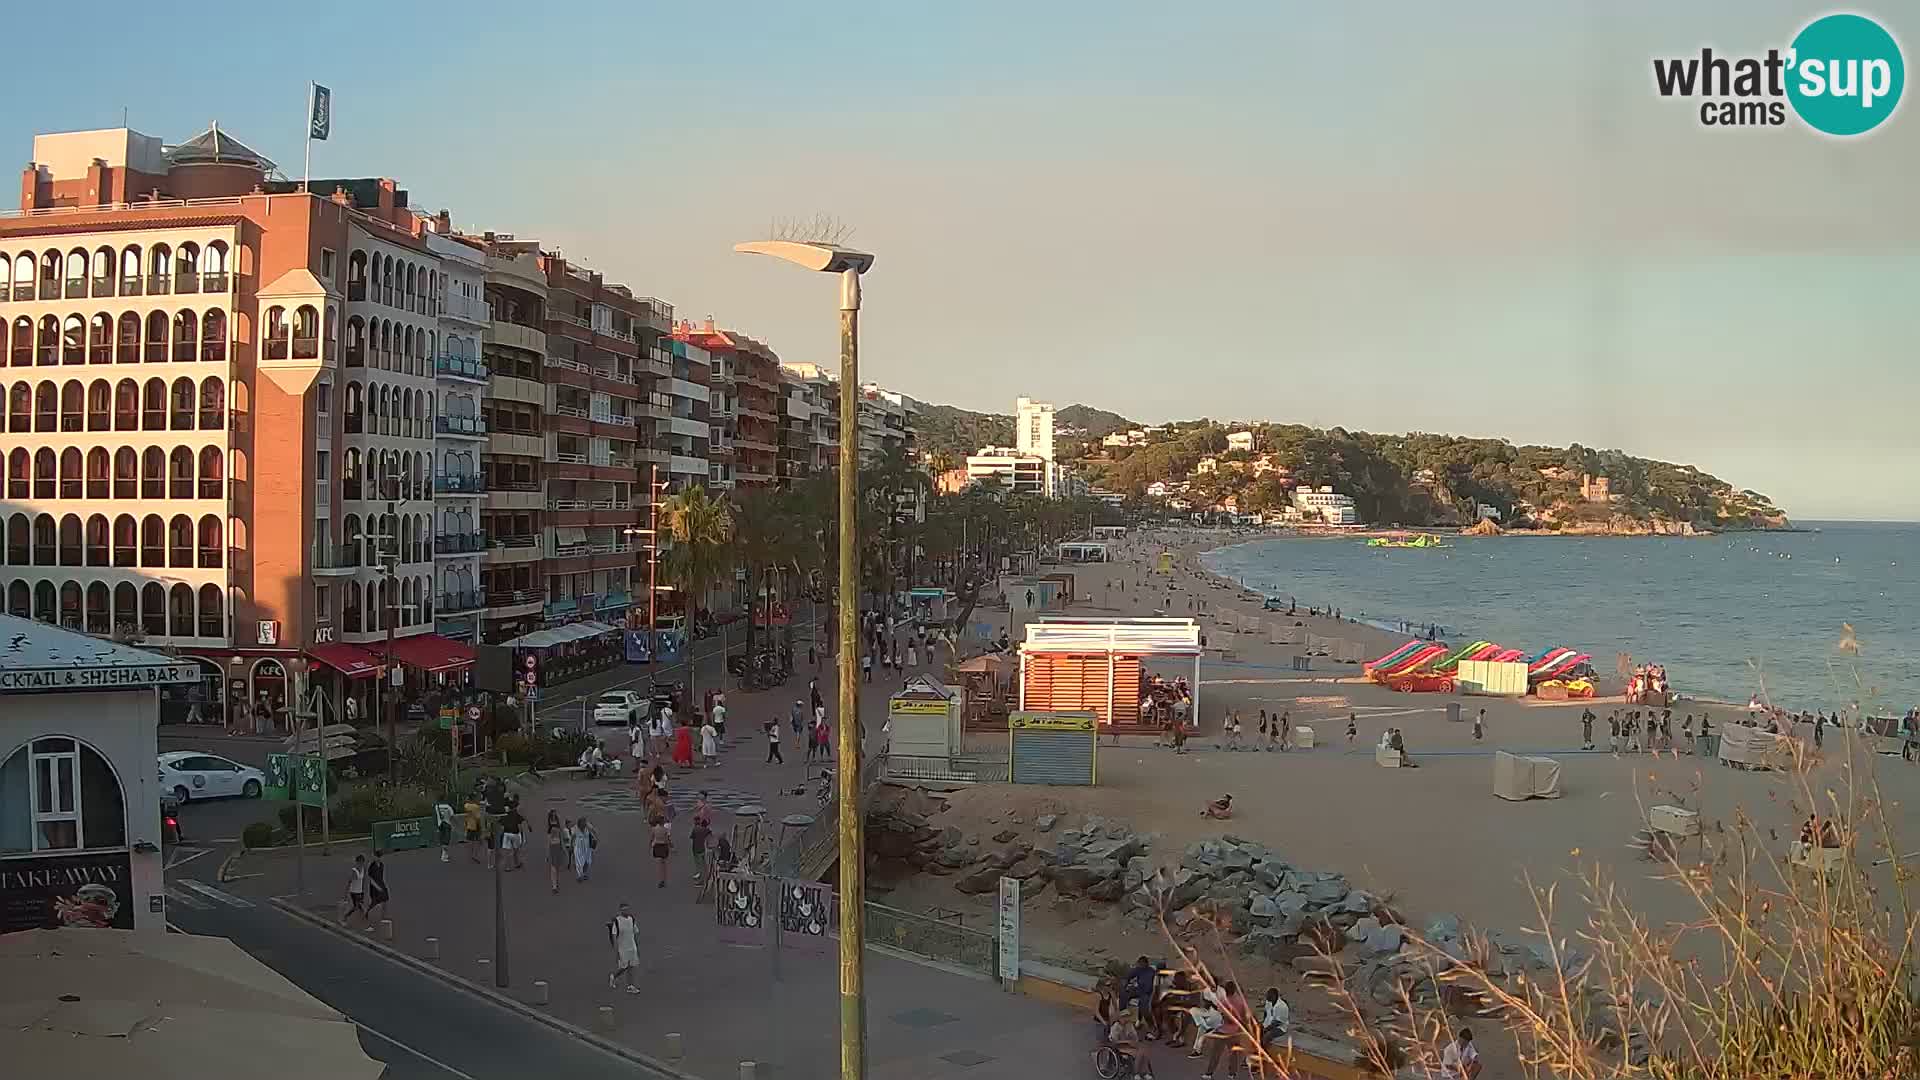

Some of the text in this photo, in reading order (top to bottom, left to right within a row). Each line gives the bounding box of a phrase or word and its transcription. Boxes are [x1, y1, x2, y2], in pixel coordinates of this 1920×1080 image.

[315, 627, 333, 643] KFC
[65, 671, 75, 685] &
[80, 668, 141, 685] SHISHA
[148, 667, 179, 682] BAR
[260, 665, 282, 676] KFC
[0, 864, 122, 889] TAKEAWAY
